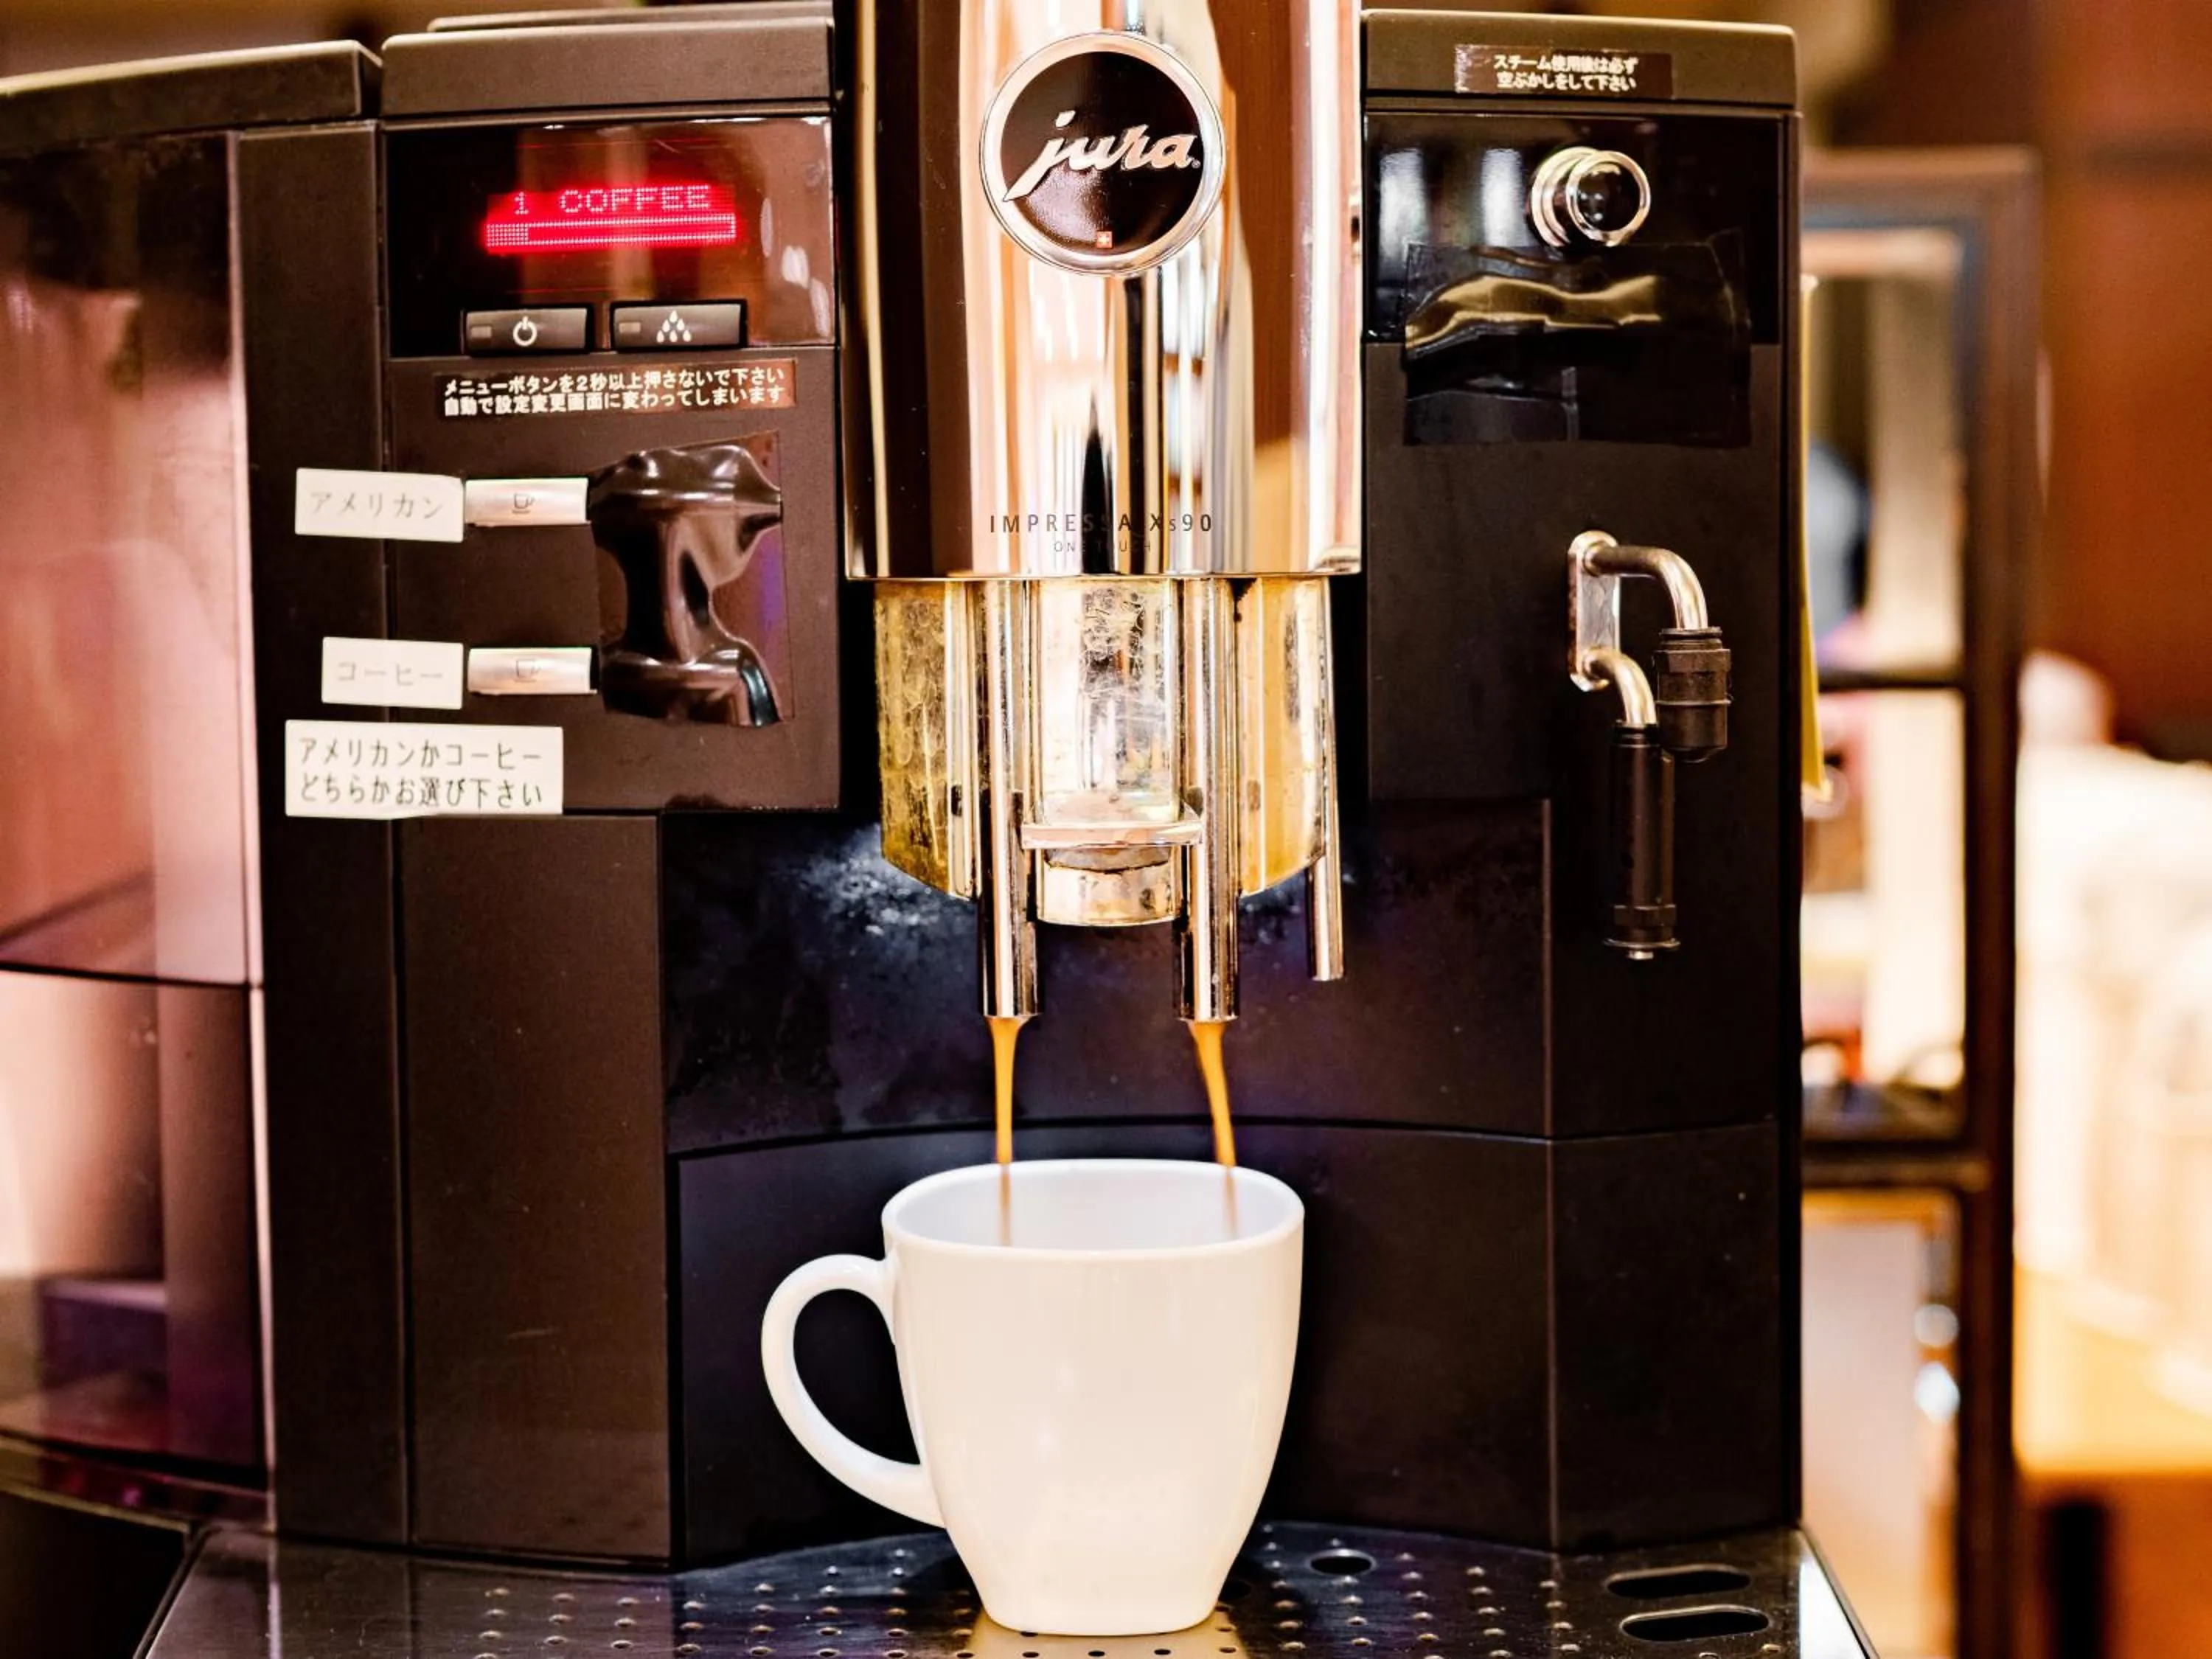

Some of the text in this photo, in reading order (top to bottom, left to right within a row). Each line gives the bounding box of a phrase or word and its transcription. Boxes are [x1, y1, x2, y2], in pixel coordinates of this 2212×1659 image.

[1497, 72, 1636, 91] 空ぶかしをして下さい
[513, 184, 711, 215] 1 COFFEE
[445, 385, 784, 417] 自動で設定変更画面に変わってしまいます
[310, 492, 442, 519] アメリカン
[337, 662, 443, 686] コーヒー
[299, 738, 541, 770] アメリカンかコーヒー
[300, 773, 541, 807] どちらかお選び下さい
